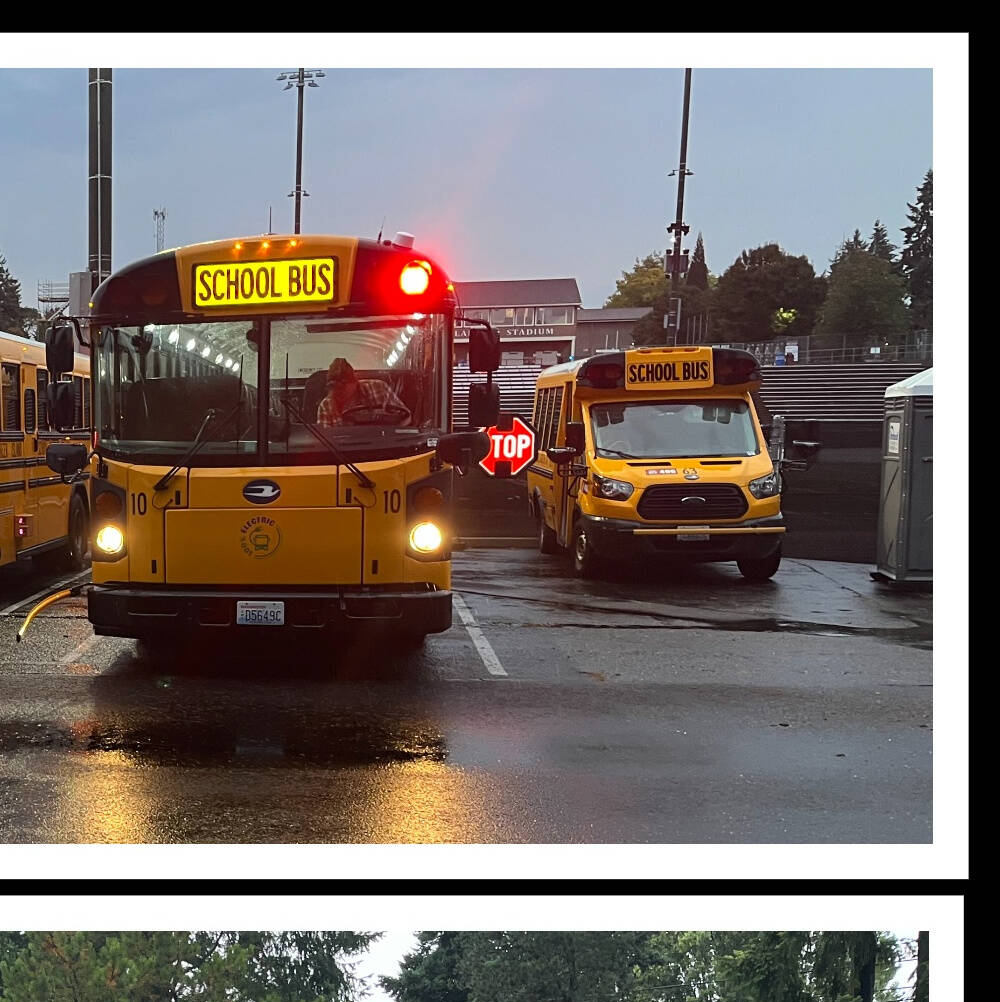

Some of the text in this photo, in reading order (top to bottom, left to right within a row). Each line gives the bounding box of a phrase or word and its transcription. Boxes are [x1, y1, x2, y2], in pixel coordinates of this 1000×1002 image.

[198, 263, 331, 301] SCHOOL BUS
[506, 327, 554, 336] STADIUM
[629, 361, 709, 382] SCHOOL BUS
[491, 433, 531, 459] TOP
[130, 492, 147, 516] 10
[383, 488, 401, 514] 10
[240, 516, 276, 533] ELECTRIC
[245, 609, 282, 621] D5649C
